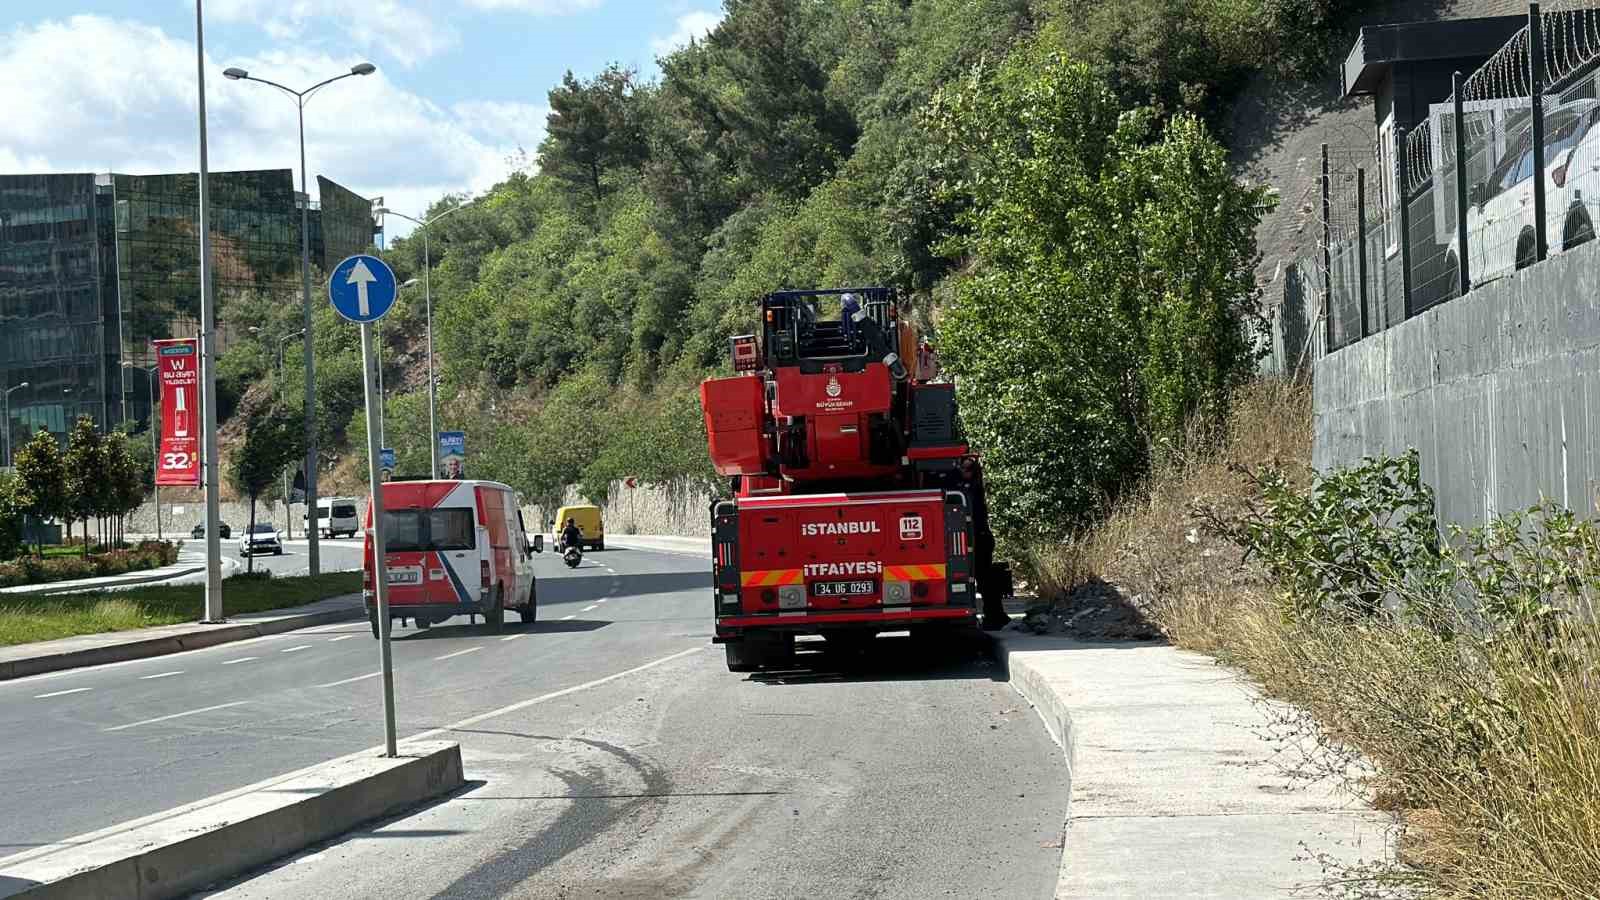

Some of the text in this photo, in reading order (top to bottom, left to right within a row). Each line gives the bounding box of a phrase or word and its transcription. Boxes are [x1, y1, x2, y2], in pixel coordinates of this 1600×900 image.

[170, 358, 185, 370] W
[902, 519, 920, 531] 112
[820, 582, 872, 594] 34 UG 0293
